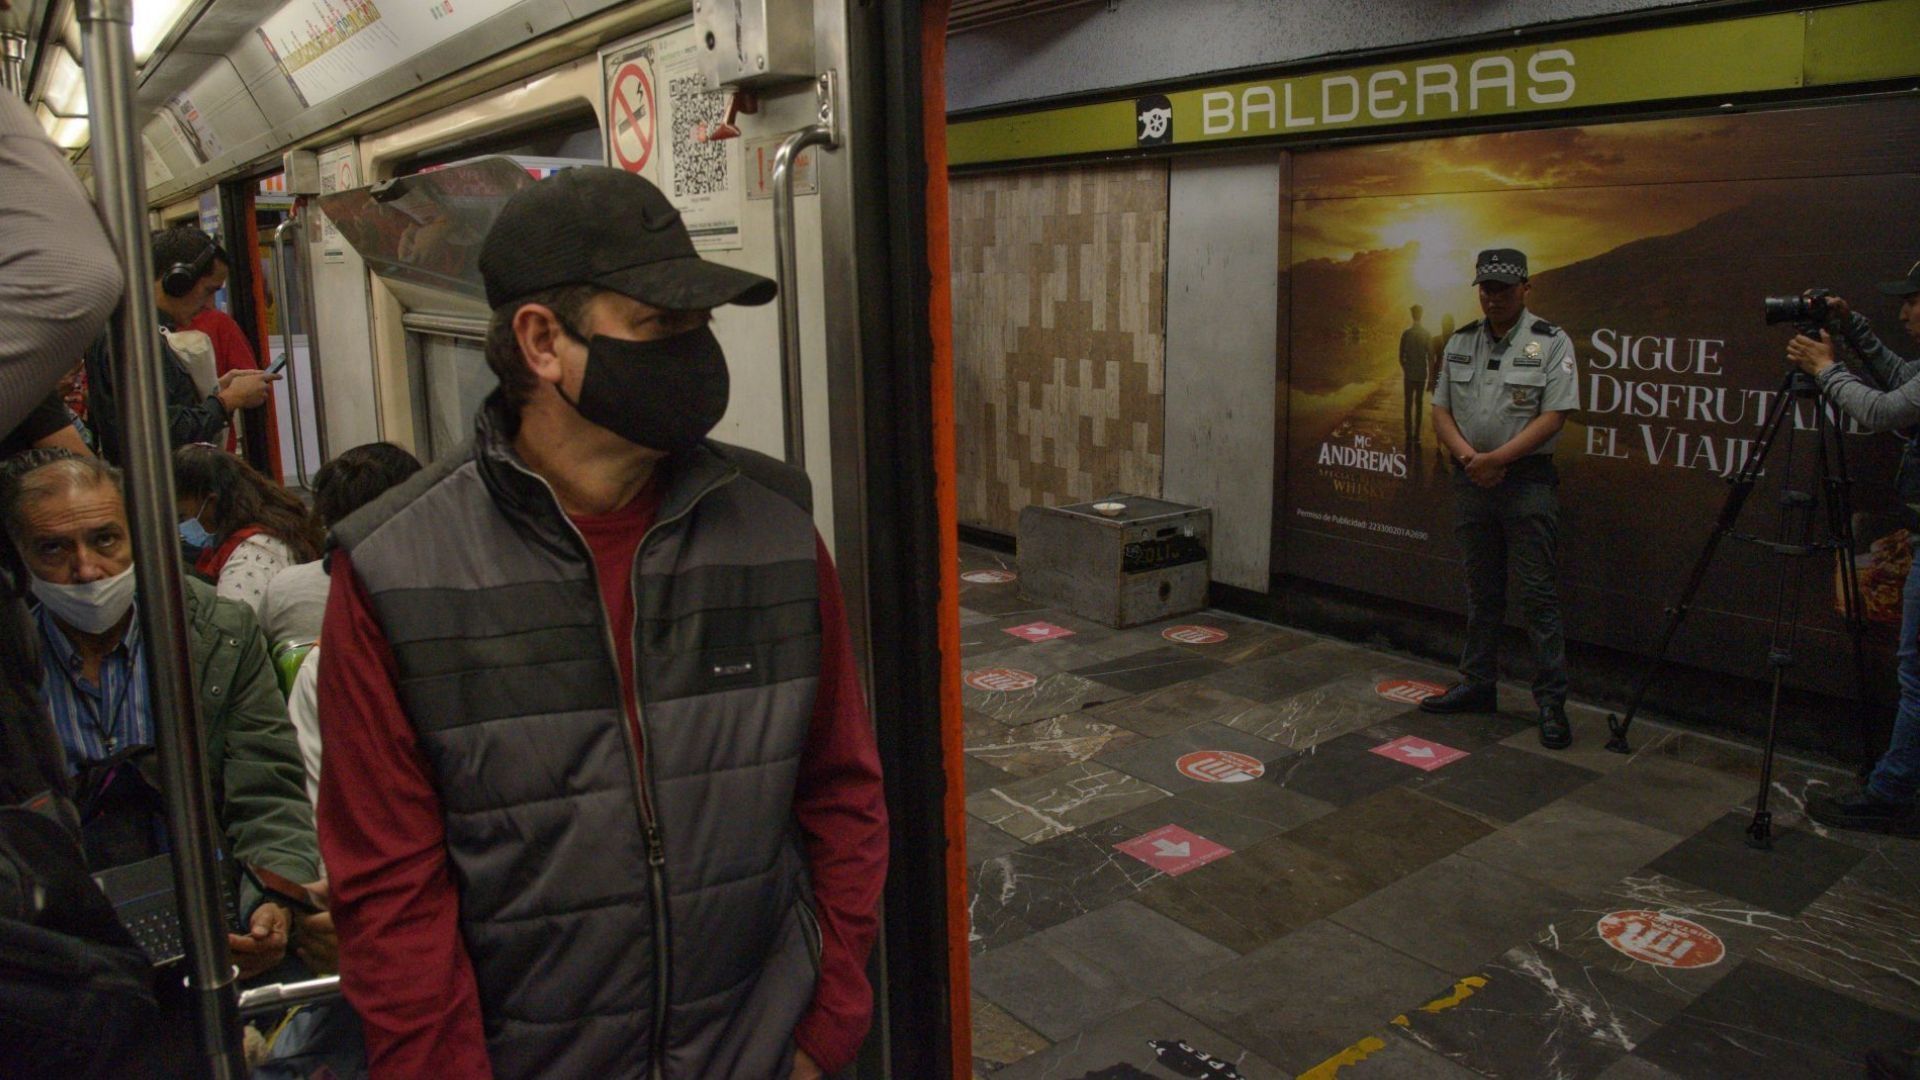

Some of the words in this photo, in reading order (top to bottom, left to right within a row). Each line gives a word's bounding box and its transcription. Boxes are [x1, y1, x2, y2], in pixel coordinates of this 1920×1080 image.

[1203, 49, 1576, 135] BALDERAS
[1589, 328, 1725, 376] SIGUE
[1318, 442, 1407, 478] ANDREW'S
[1585, 425, 1629, 459] EL
[1638, 423, 1768, 478] VIAJE
